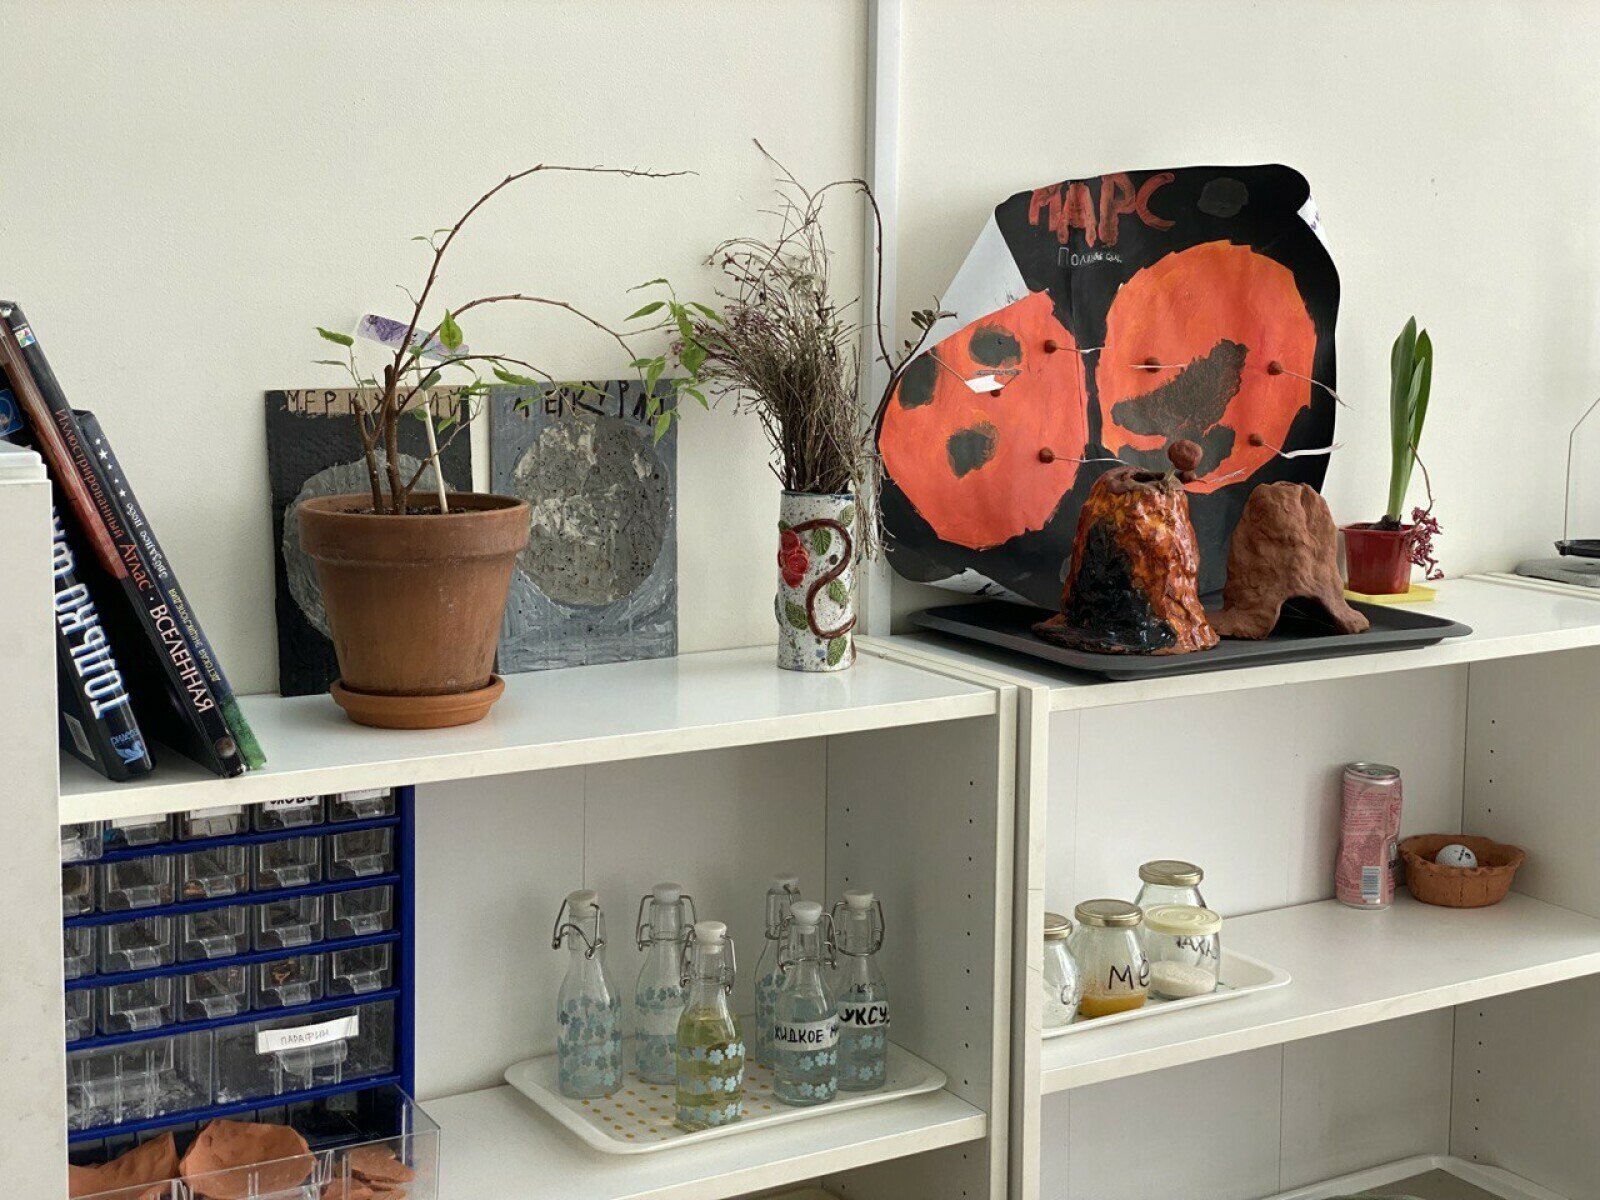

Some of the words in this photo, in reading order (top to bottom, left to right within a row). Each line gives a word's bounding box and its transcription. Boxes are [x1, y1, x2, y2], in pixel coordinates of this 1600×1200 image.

[1029, 172, 1176, 248] МАРС
[55, 583, 130, 720] ТОЛЬКО
[150, 604, 214, 713] ВСЕЛЕННАЯ
[199, 649, 221, 683] ДЕТСКАЯ
[840, 1006, 890, 1026] УКСУ
